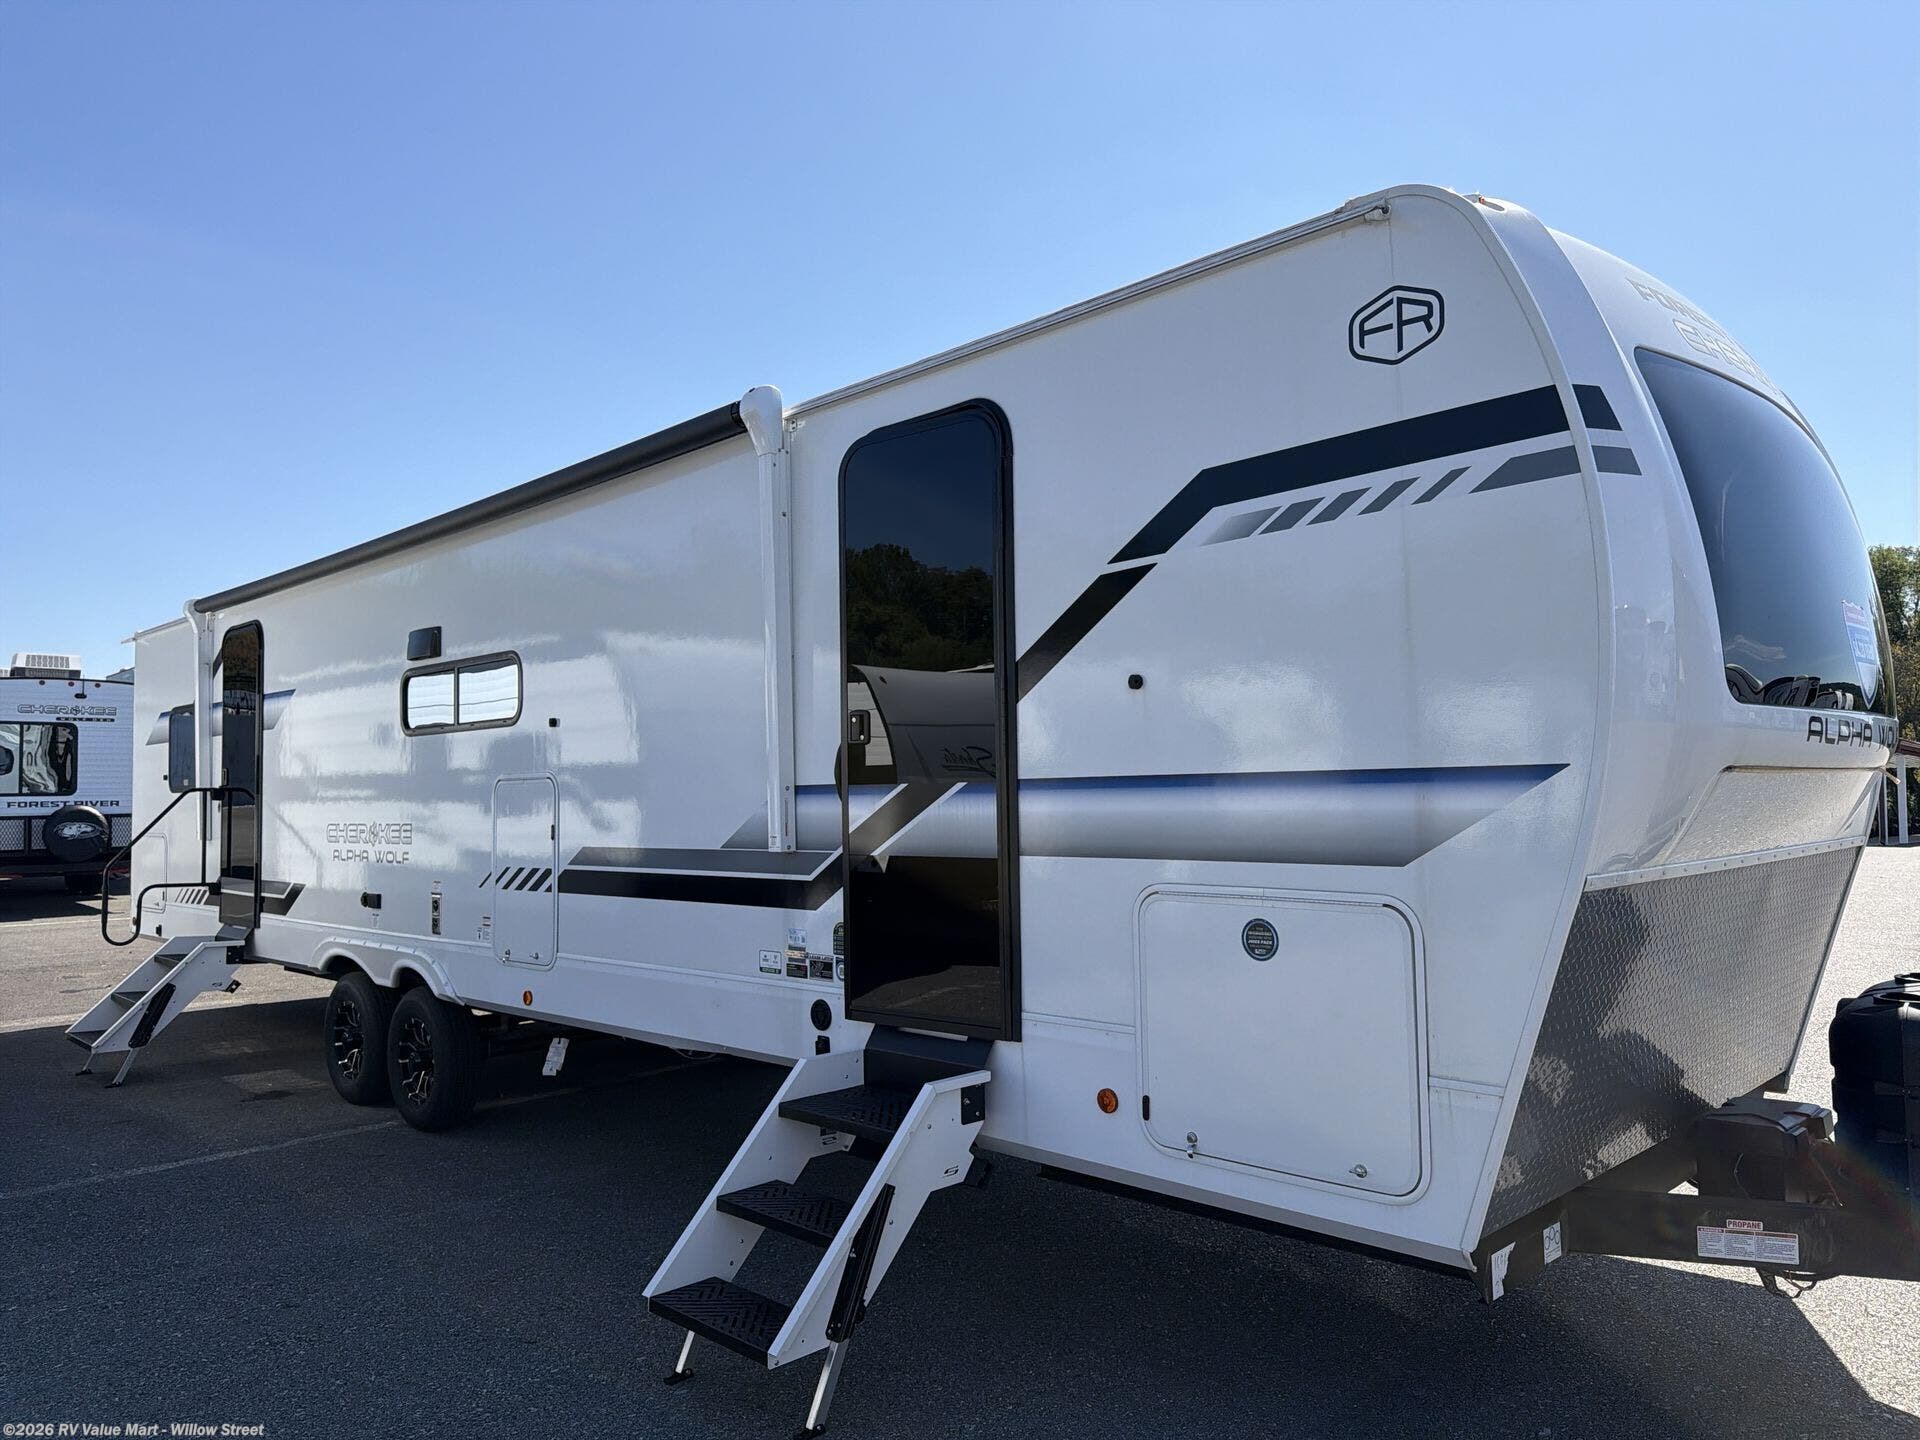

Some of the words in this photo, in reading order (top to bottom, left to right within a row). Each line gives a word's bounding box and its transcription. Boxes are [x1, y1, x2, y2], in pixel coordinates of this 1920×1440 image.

[1806, 716, 1872, 747] ALPHA
[332, 849, 369, 862] ALPHA
[375, 850, 409, 864] WOLF
[1728, 1221, 1762, 1229] PROPANE
